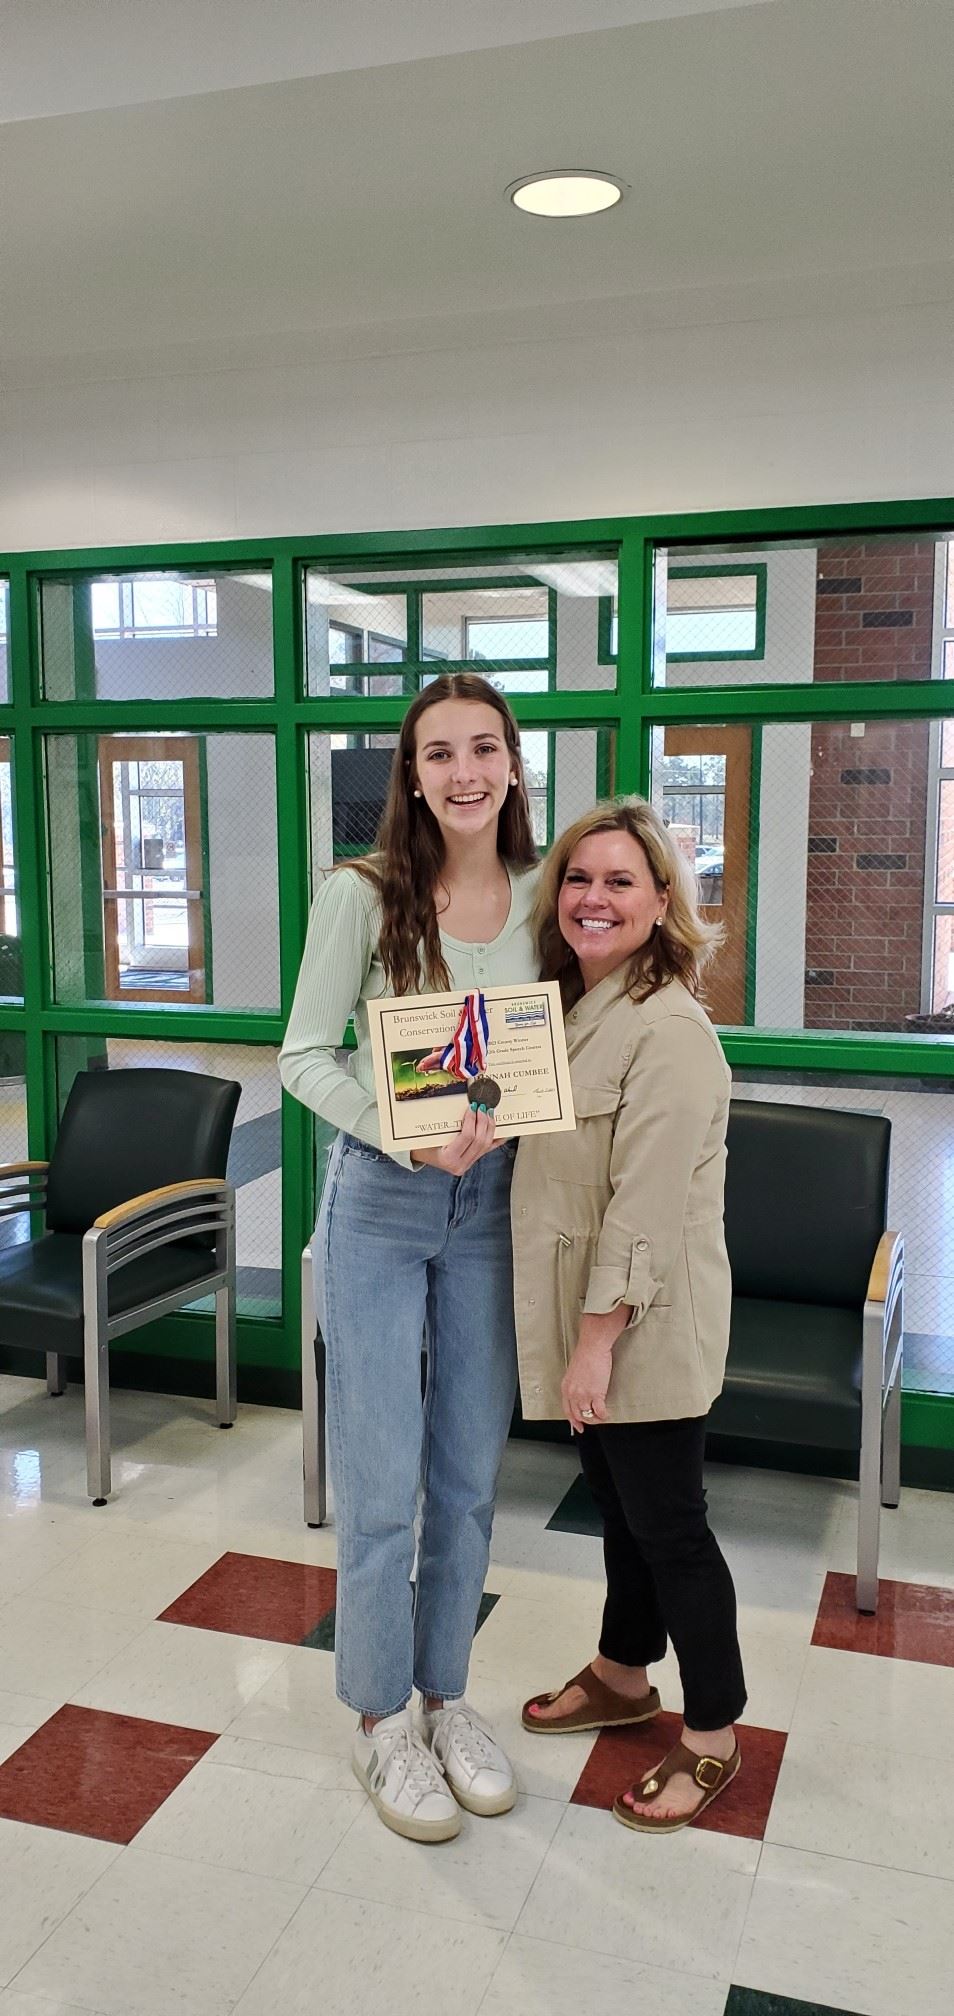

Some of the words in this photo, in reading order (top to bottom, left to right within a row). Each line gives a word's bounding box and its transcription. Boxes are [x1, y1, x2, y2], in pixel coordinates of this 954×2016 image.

[393, 1012, 438, 1023] Brunswick
[440, 1010, 456, 1019] Soil
[399, 1024, 456, 1037] Conservation
[513, 1067, 549, 1078] CUMBEE
[502, 1113, 514, 1121] OF
